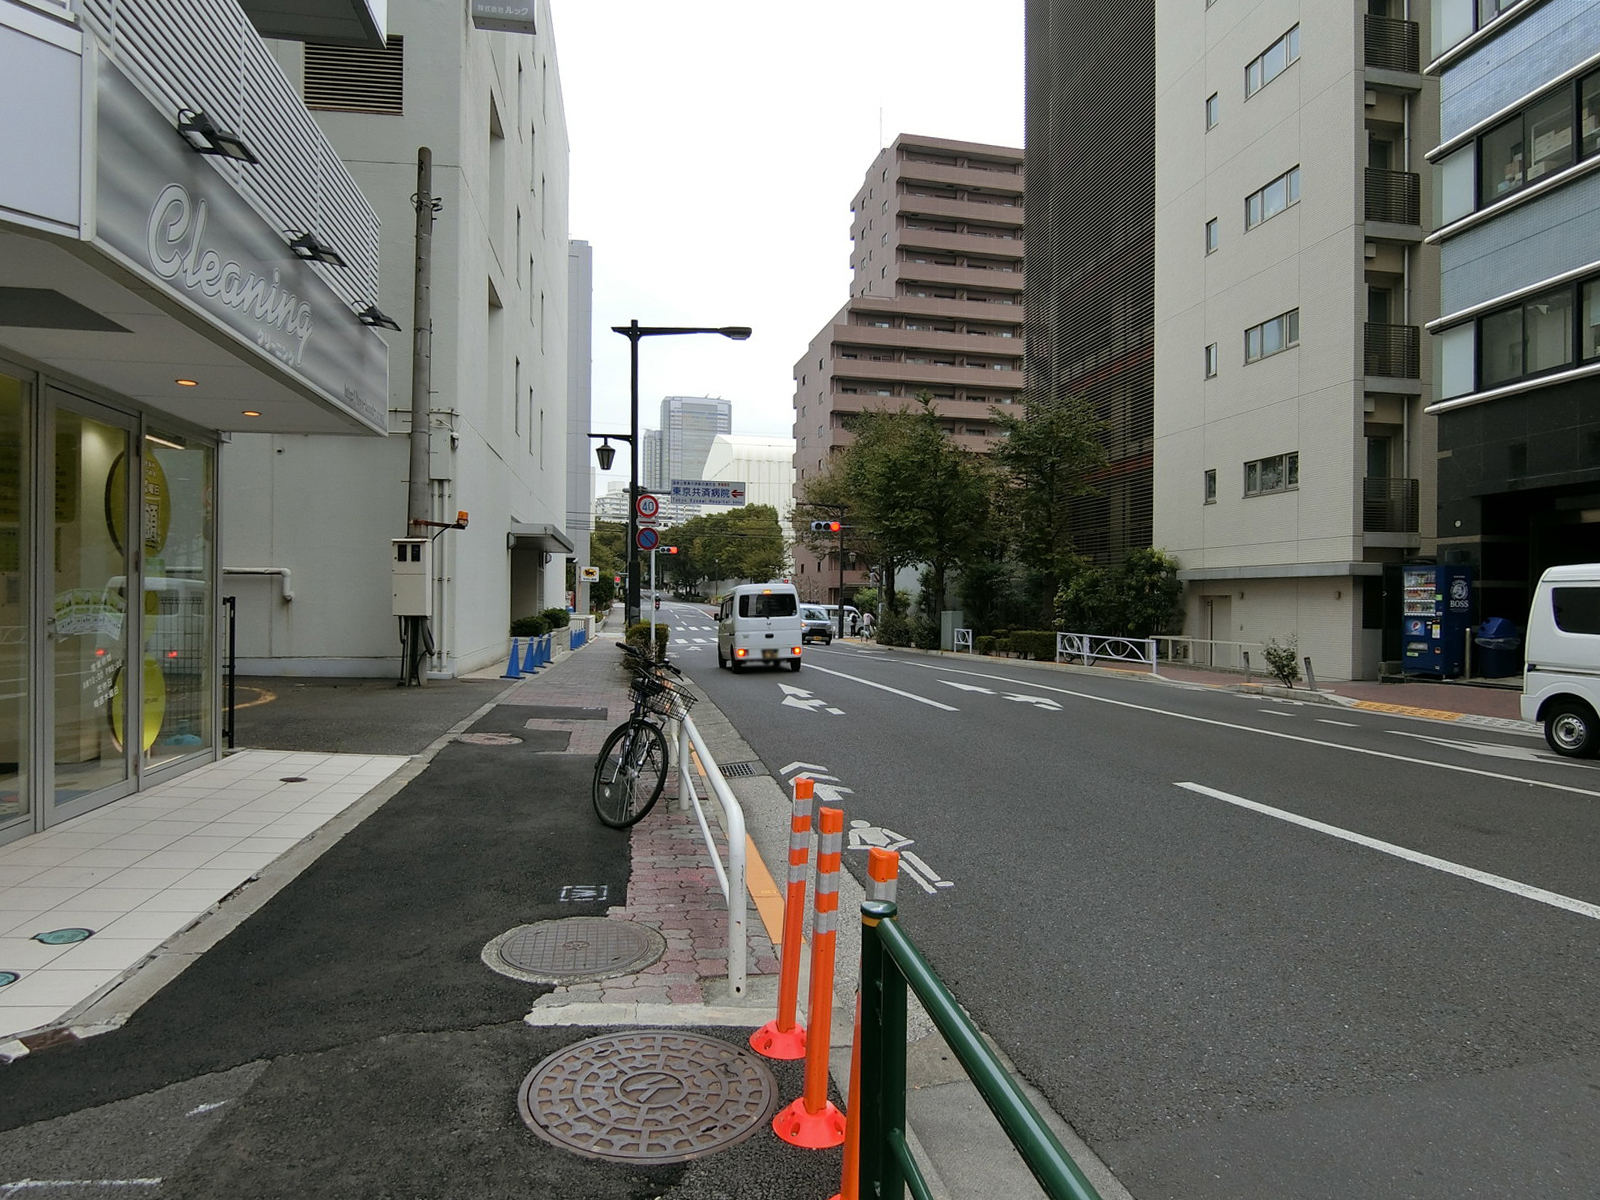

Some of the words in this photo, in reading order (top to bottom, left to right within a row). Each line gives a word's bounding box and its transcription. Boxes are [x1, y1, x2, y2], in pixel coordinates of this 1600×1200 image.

[147, 183, 313, 367] Cleaning
[672, 486, 730, 499] 東京共済病院
[641, 501, 655, 511] 40
